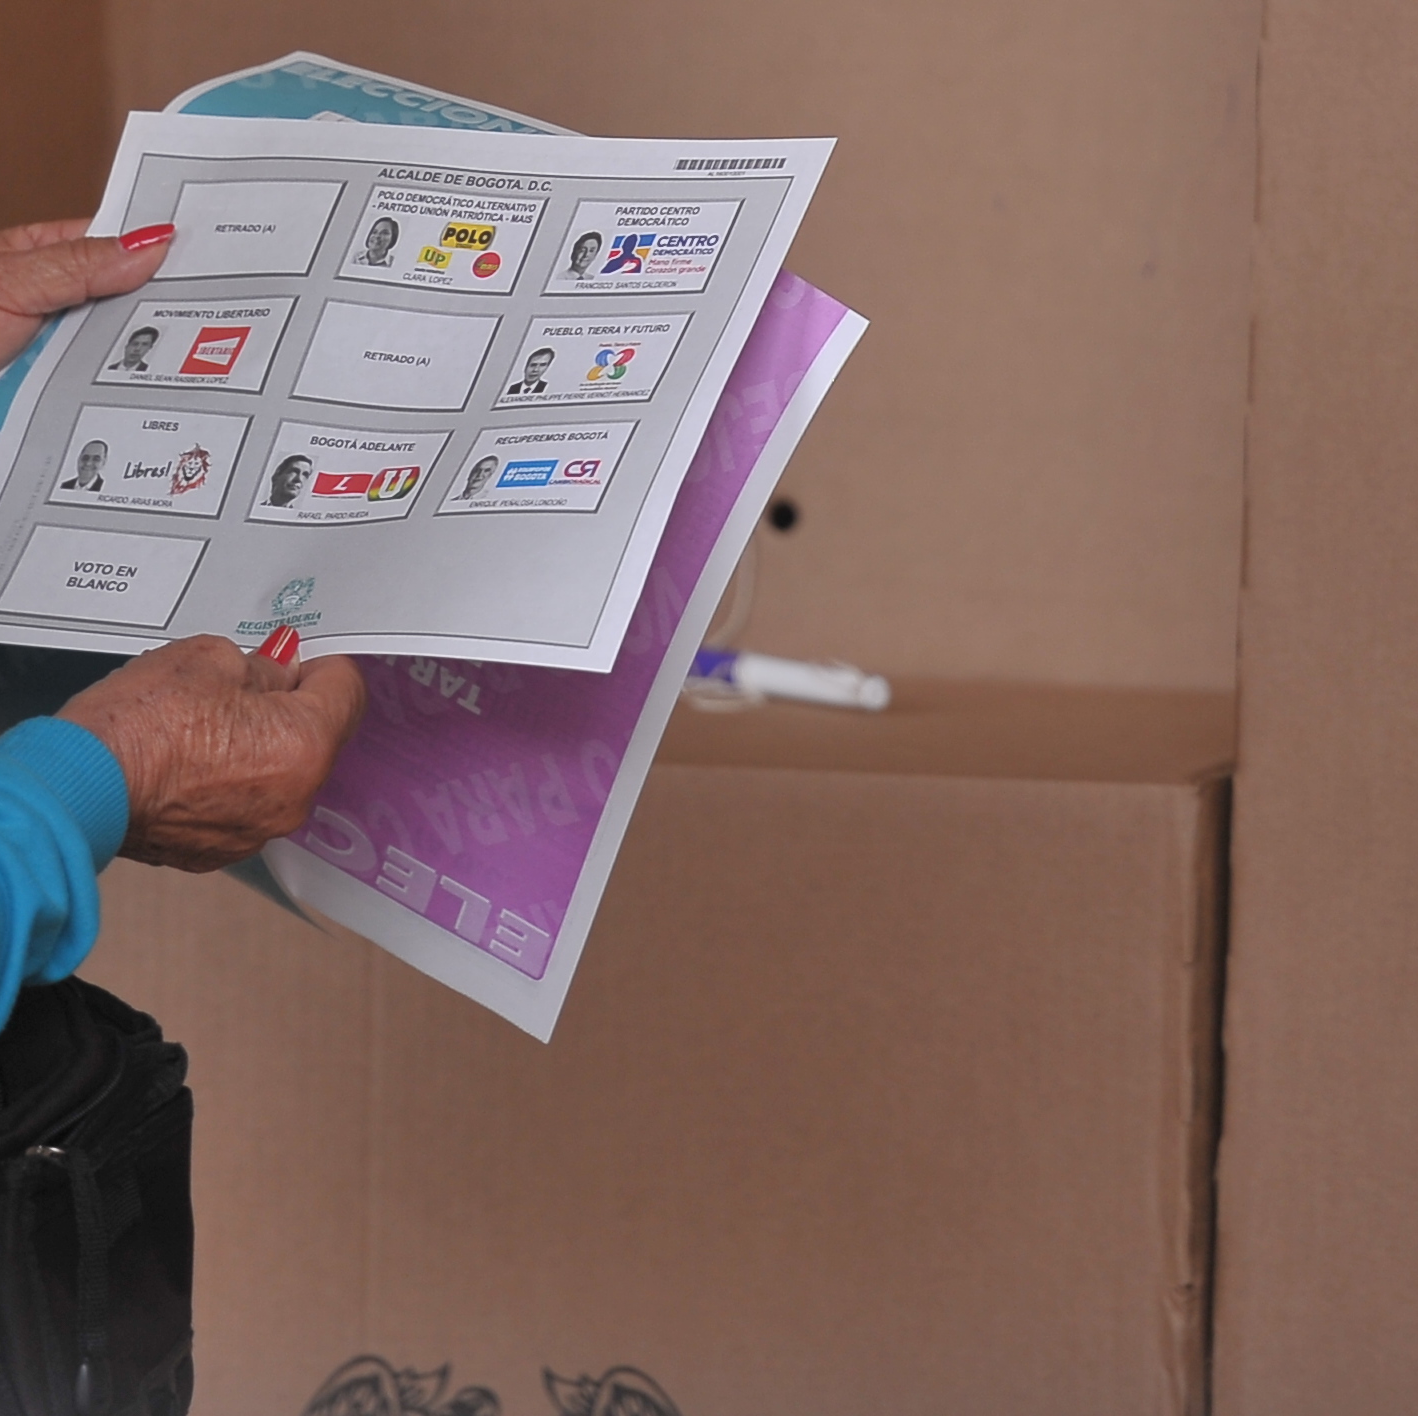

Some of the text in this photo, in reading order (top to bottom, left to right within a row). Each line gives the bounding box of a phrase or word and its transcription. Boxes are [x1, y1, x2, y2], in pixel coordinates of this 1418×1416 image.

[377, 168, 440, 183] ALCALDE
[443, 173, 464, 185] DE
[527, 180, 553, 192] D.C.
[377, 190, 537, 212] POLO DEMOCRÁTICO ALTERNATIVO
[377, 202, 418, 214] PARTIDO
[419, 206, 449, 217] UNIÓN
[450, 209, 504, 222] PATRIÓTICA
[510, 213, 534, 224] MAIS
[614, 206, 701, 215] PARTIDO CENTRO
[215, 224, 276, 233] RETIRADO (A)
[617, 216, 690, 227] DEMOCRÁTICO
[442, 227, 493, 245] POLO
[656, 234, 719, 247] CENTRO
[424, 249, 446, 266] UP
[402, 272, 426, 282] CLARA
[152, 308, 271, 319] MOVIMIENTO LIBERTARIO
[587, 326, 620, 335] TIERRA
[623, 326, 630, 334] Y
[630, 324, 671, 333] FUTURO
[363, 350, 431, 367] RETIRADO (A)
[142, 420, 180, 431] LIBRES
[309, 436, 416, 452] BOGOTÁ ADELANTE
[494, 430, 609, 445] RECUPEREMOS BOGOTÁ
[123, 461, 173, 480] Libres!
[332, 476, 352, 491] L
[378, 468, 413, 499] U
[97, 495, 129, 504] RICARDO
[73, 561, 138, 578] VOTO EN
[66, 576, 129, 592] BLANCO
